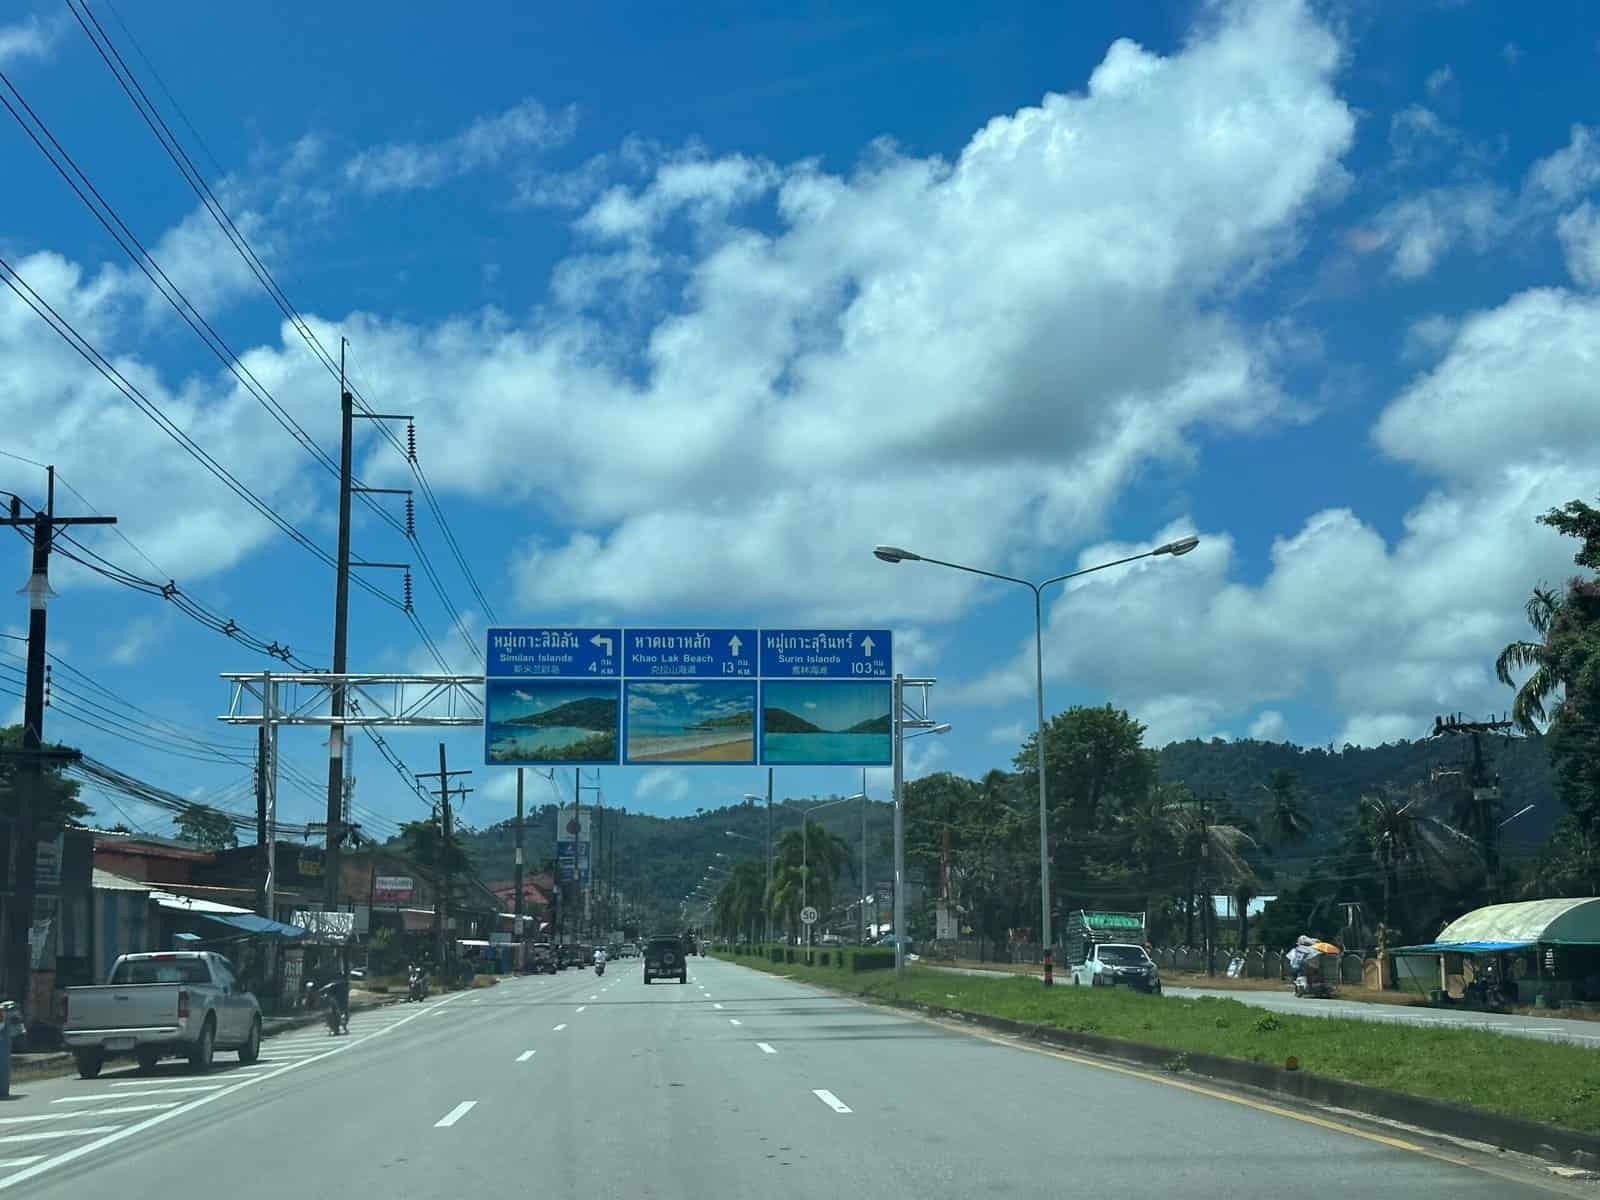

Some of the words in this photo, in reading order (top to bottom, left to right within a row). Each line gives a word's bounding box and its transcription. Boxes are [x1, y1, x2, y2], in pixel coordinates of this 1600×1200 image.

[494, 631, 580, 653] หมู่เกาะสิมิลัน
[635, 632, 711, 649] หาดเขาหลัก
[766, 632, 854, 653] หมู่เกาะสุรินทร์
[538, 654, 574, 663] Islands
[632, 654, 657, 663] Khao
[661, 654, 679, 663] Lak
[683, 654, 713, 663] Beach
[778, 655, 804, 663] Surin
[807, 655, 841, 663] Islands
[588, 661, 597, 673] 4
[721, 662, 735, 673] 13
[851, 662, 873, 674] 103
[803, 911, 816, 920] 50
